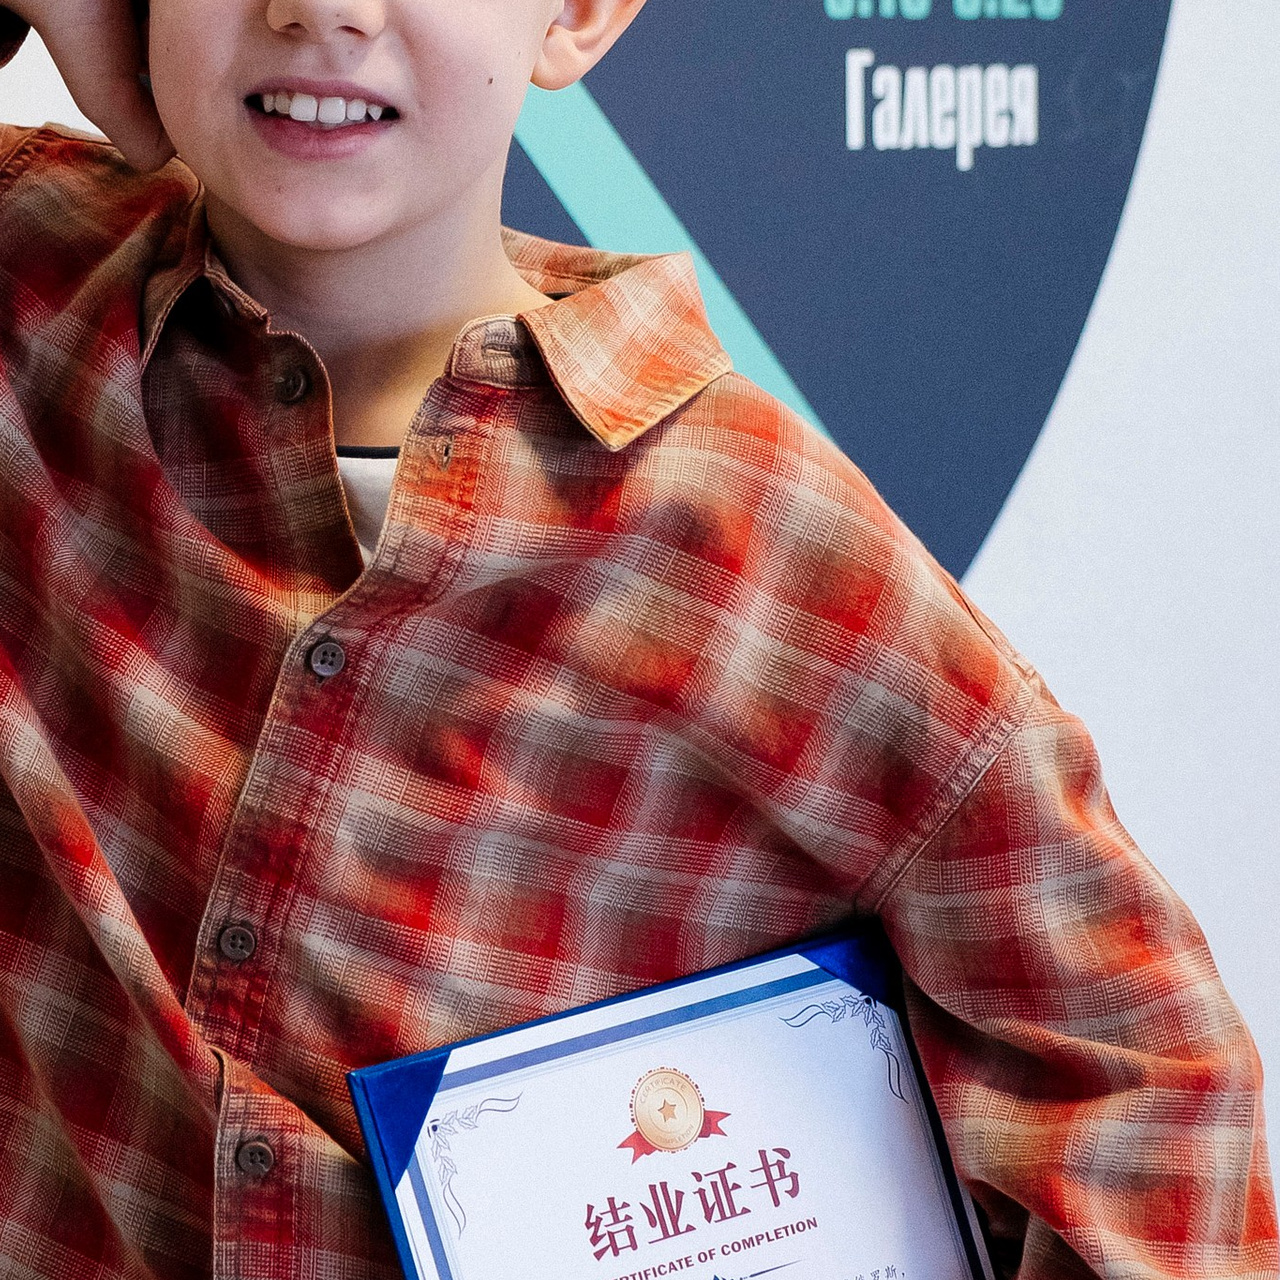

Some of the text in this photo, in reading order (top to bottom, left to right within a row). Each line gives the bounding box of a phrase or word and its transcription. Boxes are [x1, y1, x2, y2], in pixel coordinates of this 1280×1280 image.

[844, 47, 1039, 172] Галерея
[584, 1147, 800, 1262] 结业证书
[697, 1248, 716, 1264] OF
[720, 1216, 818, 1256] COMPLETION
